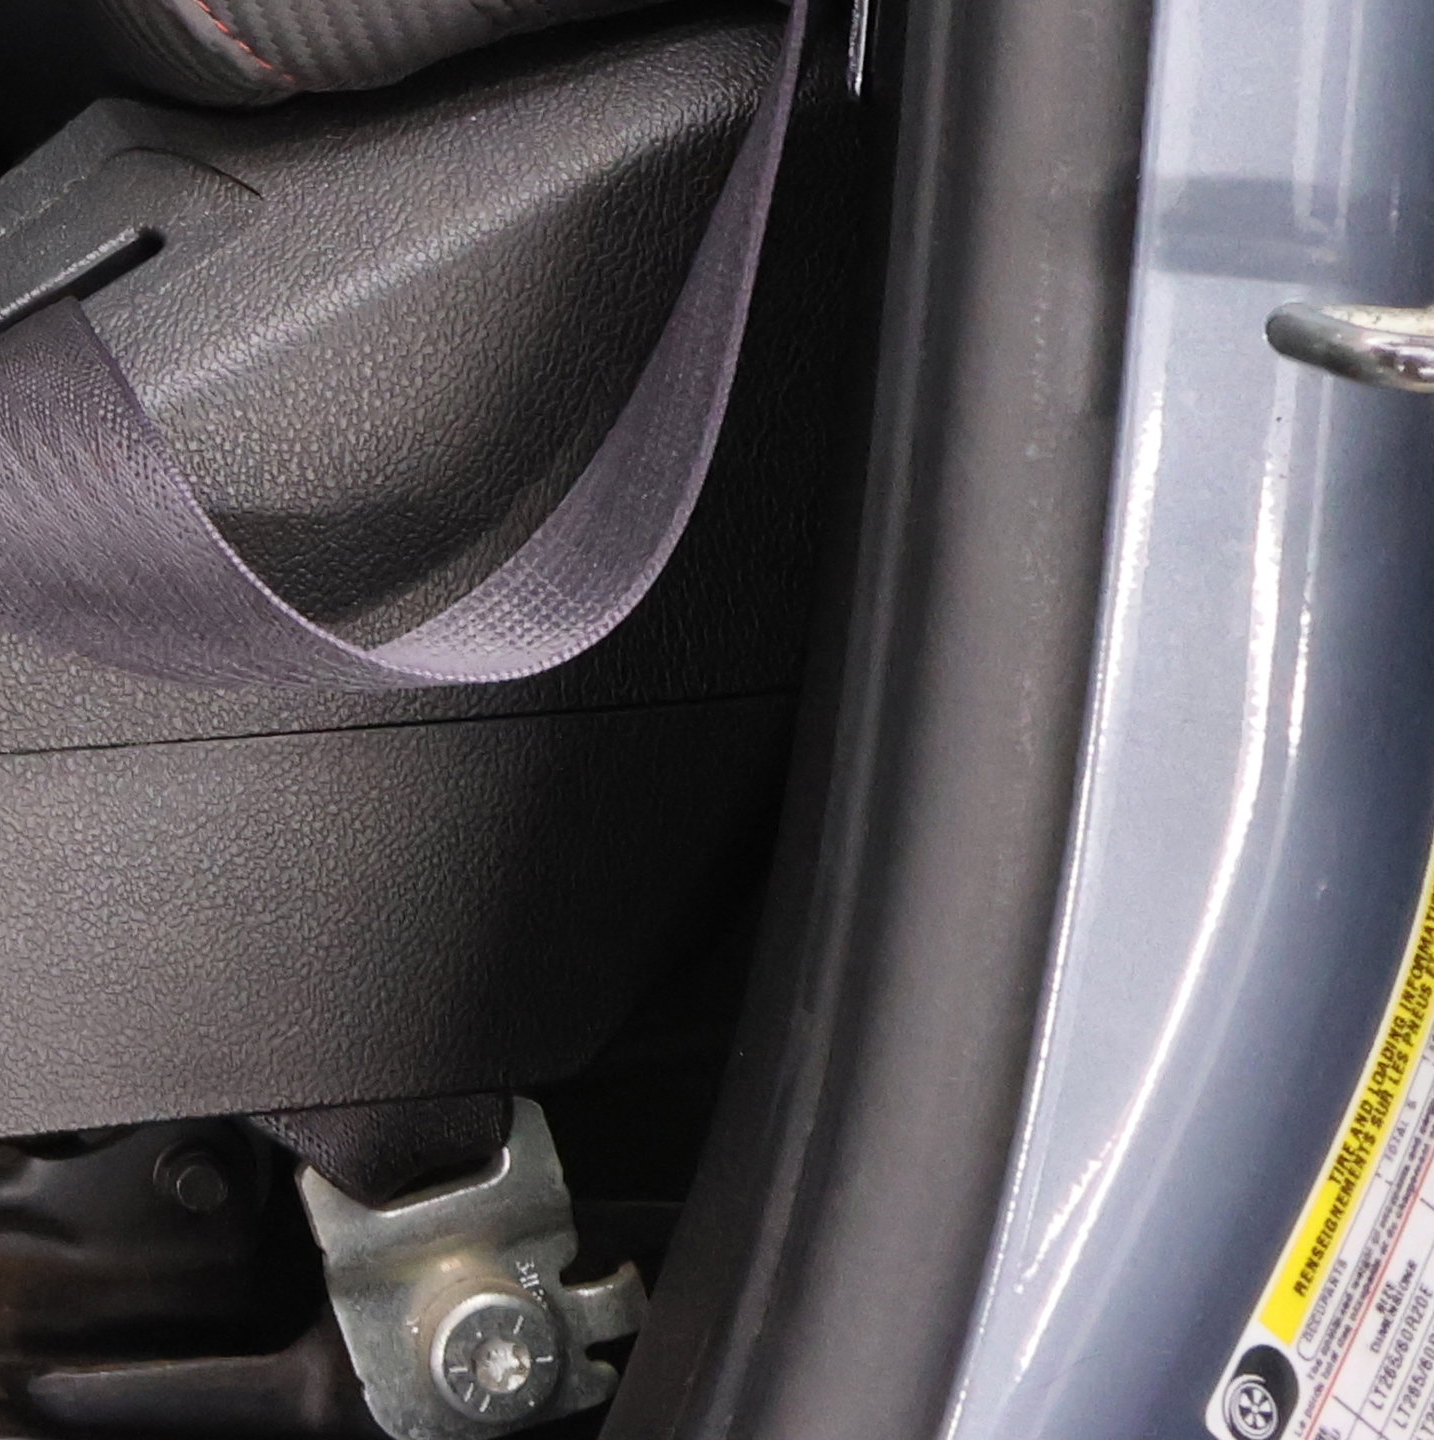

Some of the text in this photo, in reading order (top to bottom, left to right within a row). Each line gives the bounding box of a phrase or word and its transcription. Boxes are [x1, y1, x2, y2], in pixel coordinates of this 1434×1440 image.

[1293, 1132, 1376, 1297] RENSEIGNEMENTS
[1370, 1088, 1395, 1130] SUR
[1388, 1051, 1409, 1086] LES
[1402, 983, 1433, 1047] PNEUS
[1328, 1141, 1356, 1185] TIRE
[1350, 1100, 1374, 1142] AND
[1367, 1016, 1407, 1097] LOADING
[1302, 1259, 1347, 1342] OCCUPANTS
